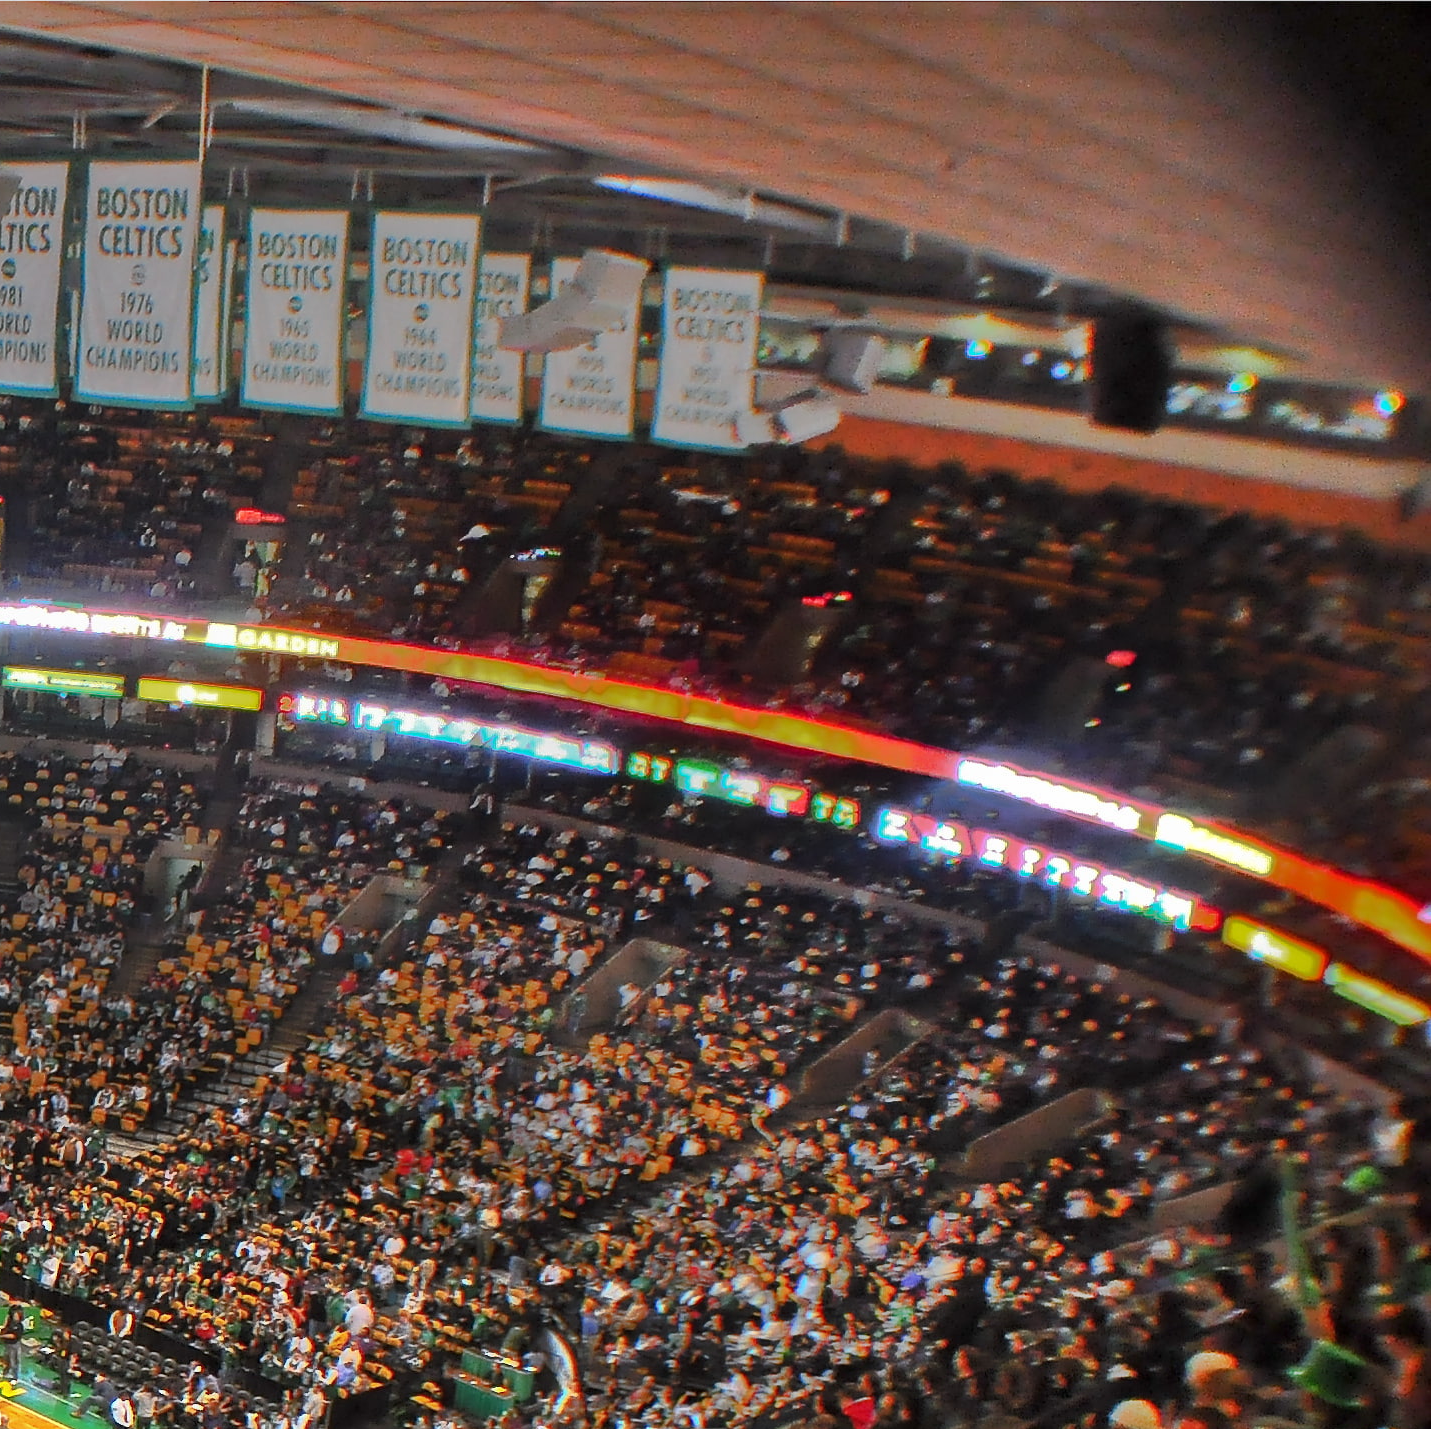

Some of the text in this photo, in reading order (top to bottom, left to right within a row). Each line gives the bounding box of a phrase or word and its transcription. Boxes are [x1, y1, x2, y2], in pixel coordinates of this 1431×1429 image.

[8, 186, 58, 217] TON
[97, 187, 188, 220] BOSTON
[99, 224, 183, 258] CELTICS
[258, 231, 337, 260] BOSTON
[383, 237, 469, 267] BOSTON
[261, 262, 333, 292] CELTICS
[385, 268, 463, 299] CELTICS
[120, 292, 153, 314] 1976
[107, 319, 163, 345] WORLD
[87, 346, 179, 374] CHAMPIONS
[269, 341, 319, 363] WORLD
[393, 351, 447, 374] WORLD
[252, 363, 332, 388] CHAMPIONS
[374, 373, 461, 399] CHAMPIONS
[237, 629, 339, 658] GARDEN
